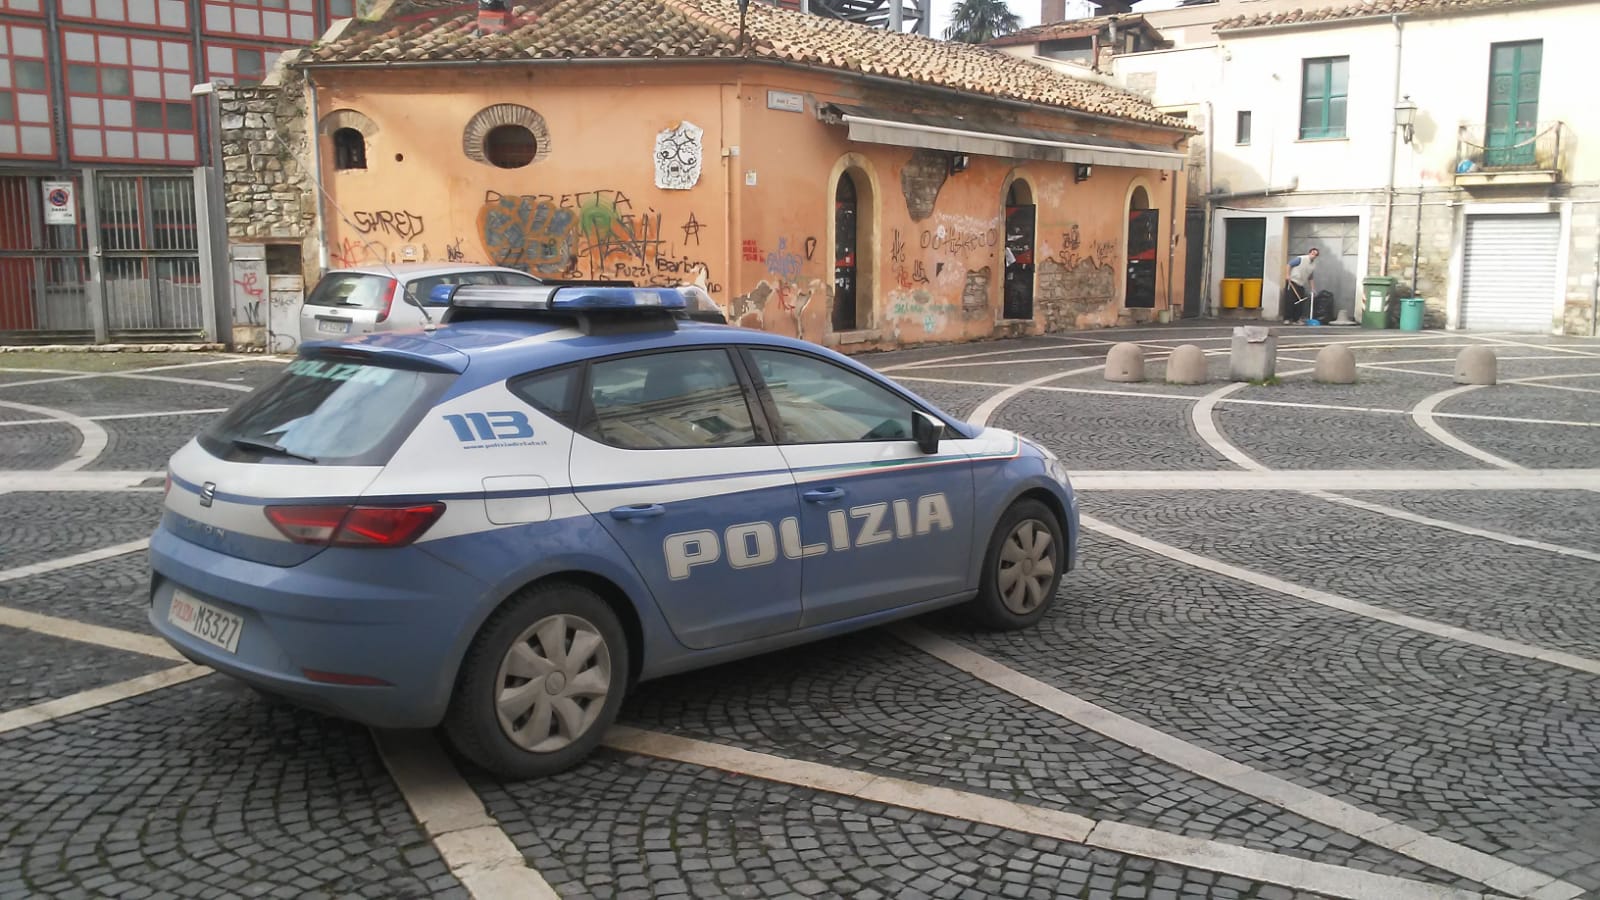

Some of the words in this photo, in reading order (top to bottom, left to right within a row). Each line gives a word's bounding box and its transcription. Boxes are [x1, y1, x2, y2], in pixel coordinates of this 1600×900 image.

[486, 186, 633, 212] PETTA
[282, 360, 397, 387] POLIZIA
[442, 410, 534, 442] 113
[663, 492, 954, 581] POLIZIA
